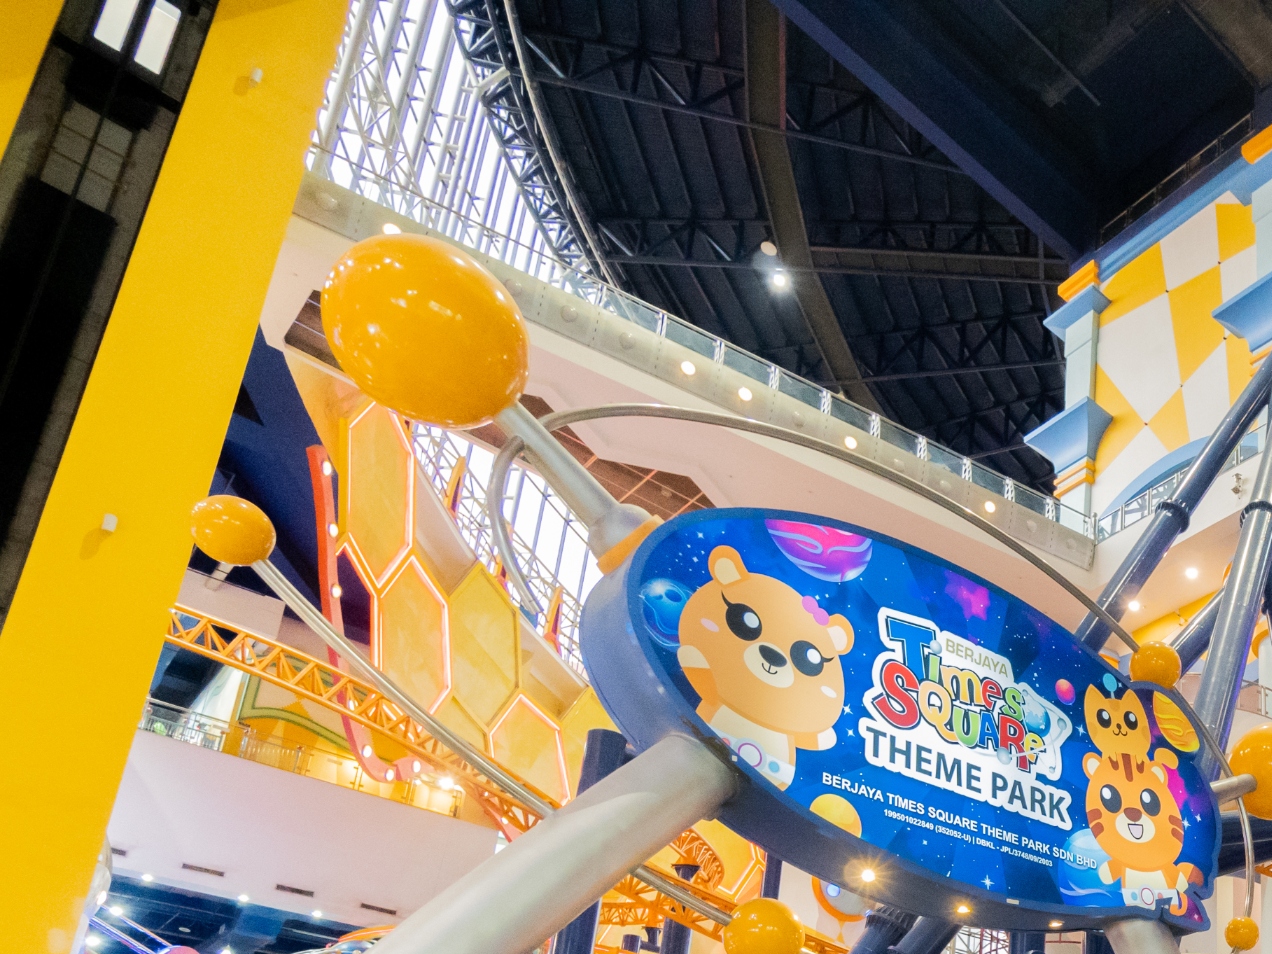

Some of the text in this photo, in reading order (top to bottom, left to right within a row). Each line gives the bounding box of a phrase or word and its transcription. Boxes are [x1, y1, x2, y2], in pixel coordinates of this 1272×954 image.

[945, 638, 1009, 678] BERJAYA
[865, 725, 1067, 823] THEME PARK
[822, 771, 1097, 869] BERJAYA TIMES SQUARE THEME PARK SDN BHD
[976, 838, 996, 850] DBKL
